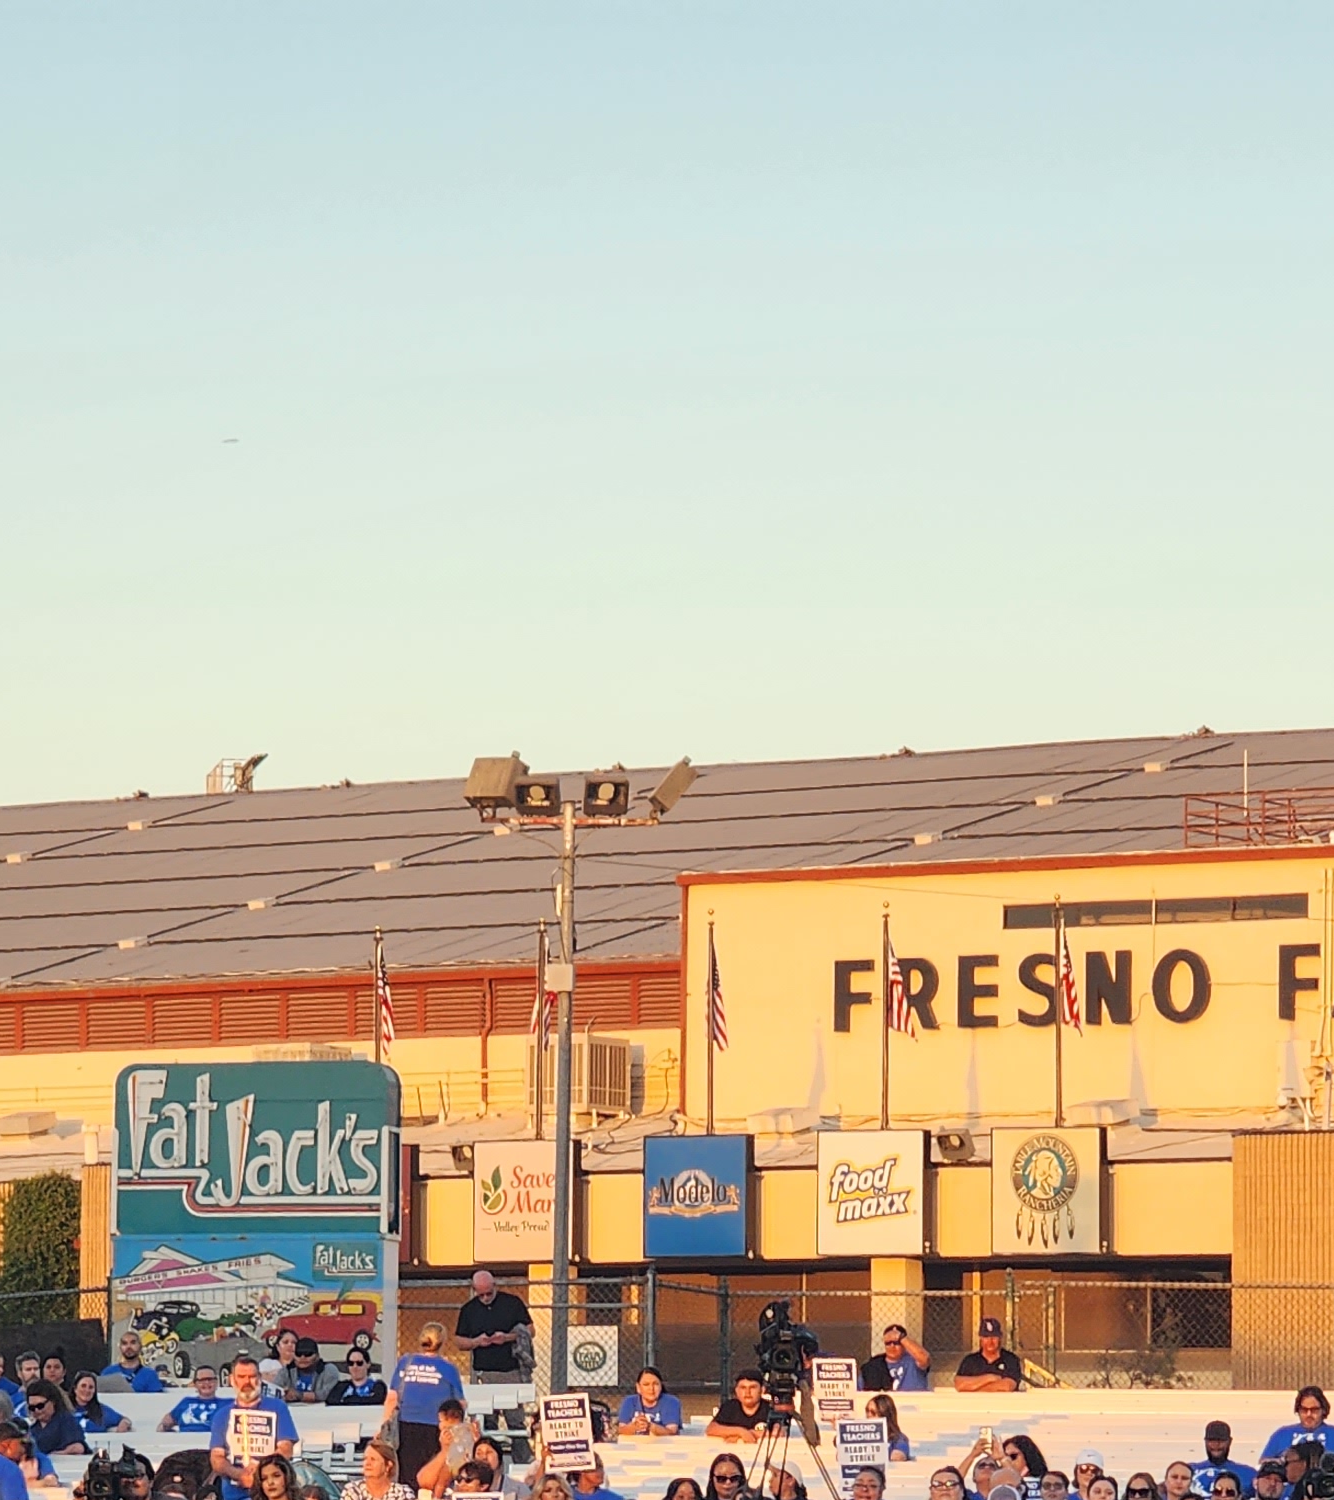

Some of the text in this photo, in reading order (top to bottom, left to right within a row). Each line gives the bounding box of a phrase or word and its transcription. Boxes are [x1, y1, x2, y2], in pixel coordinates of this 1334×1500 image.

[833, 948, 1212, 1033] FRESNO
[128, 1069, 218, 1180] Fat
[211, 1093, 379, 1207] Jack's
[510, 1166, 555, 1189] Save
[828, 1157, 898, 1203] food
[659, 1177, 727, 1204] Modelo
[1016, 1186, 1073, 1212] RANCHERIA
[509, 1191, 555, 1214] Mar
[836, 1190, 911, 1223] maxx
[227, 1257, 262, 1269] FRIES
[546, 1408, 584, 1418] TEACHERS
[550, 1399, 579, 1410] FRESNO
[842, 1433, 881, 1443] TEACHERS
[845, 1424, 877, 1433] FRESNO
[843, 1445, 881, 1454] READY TO
[849, 1454, 875, 1463] STRIKE
